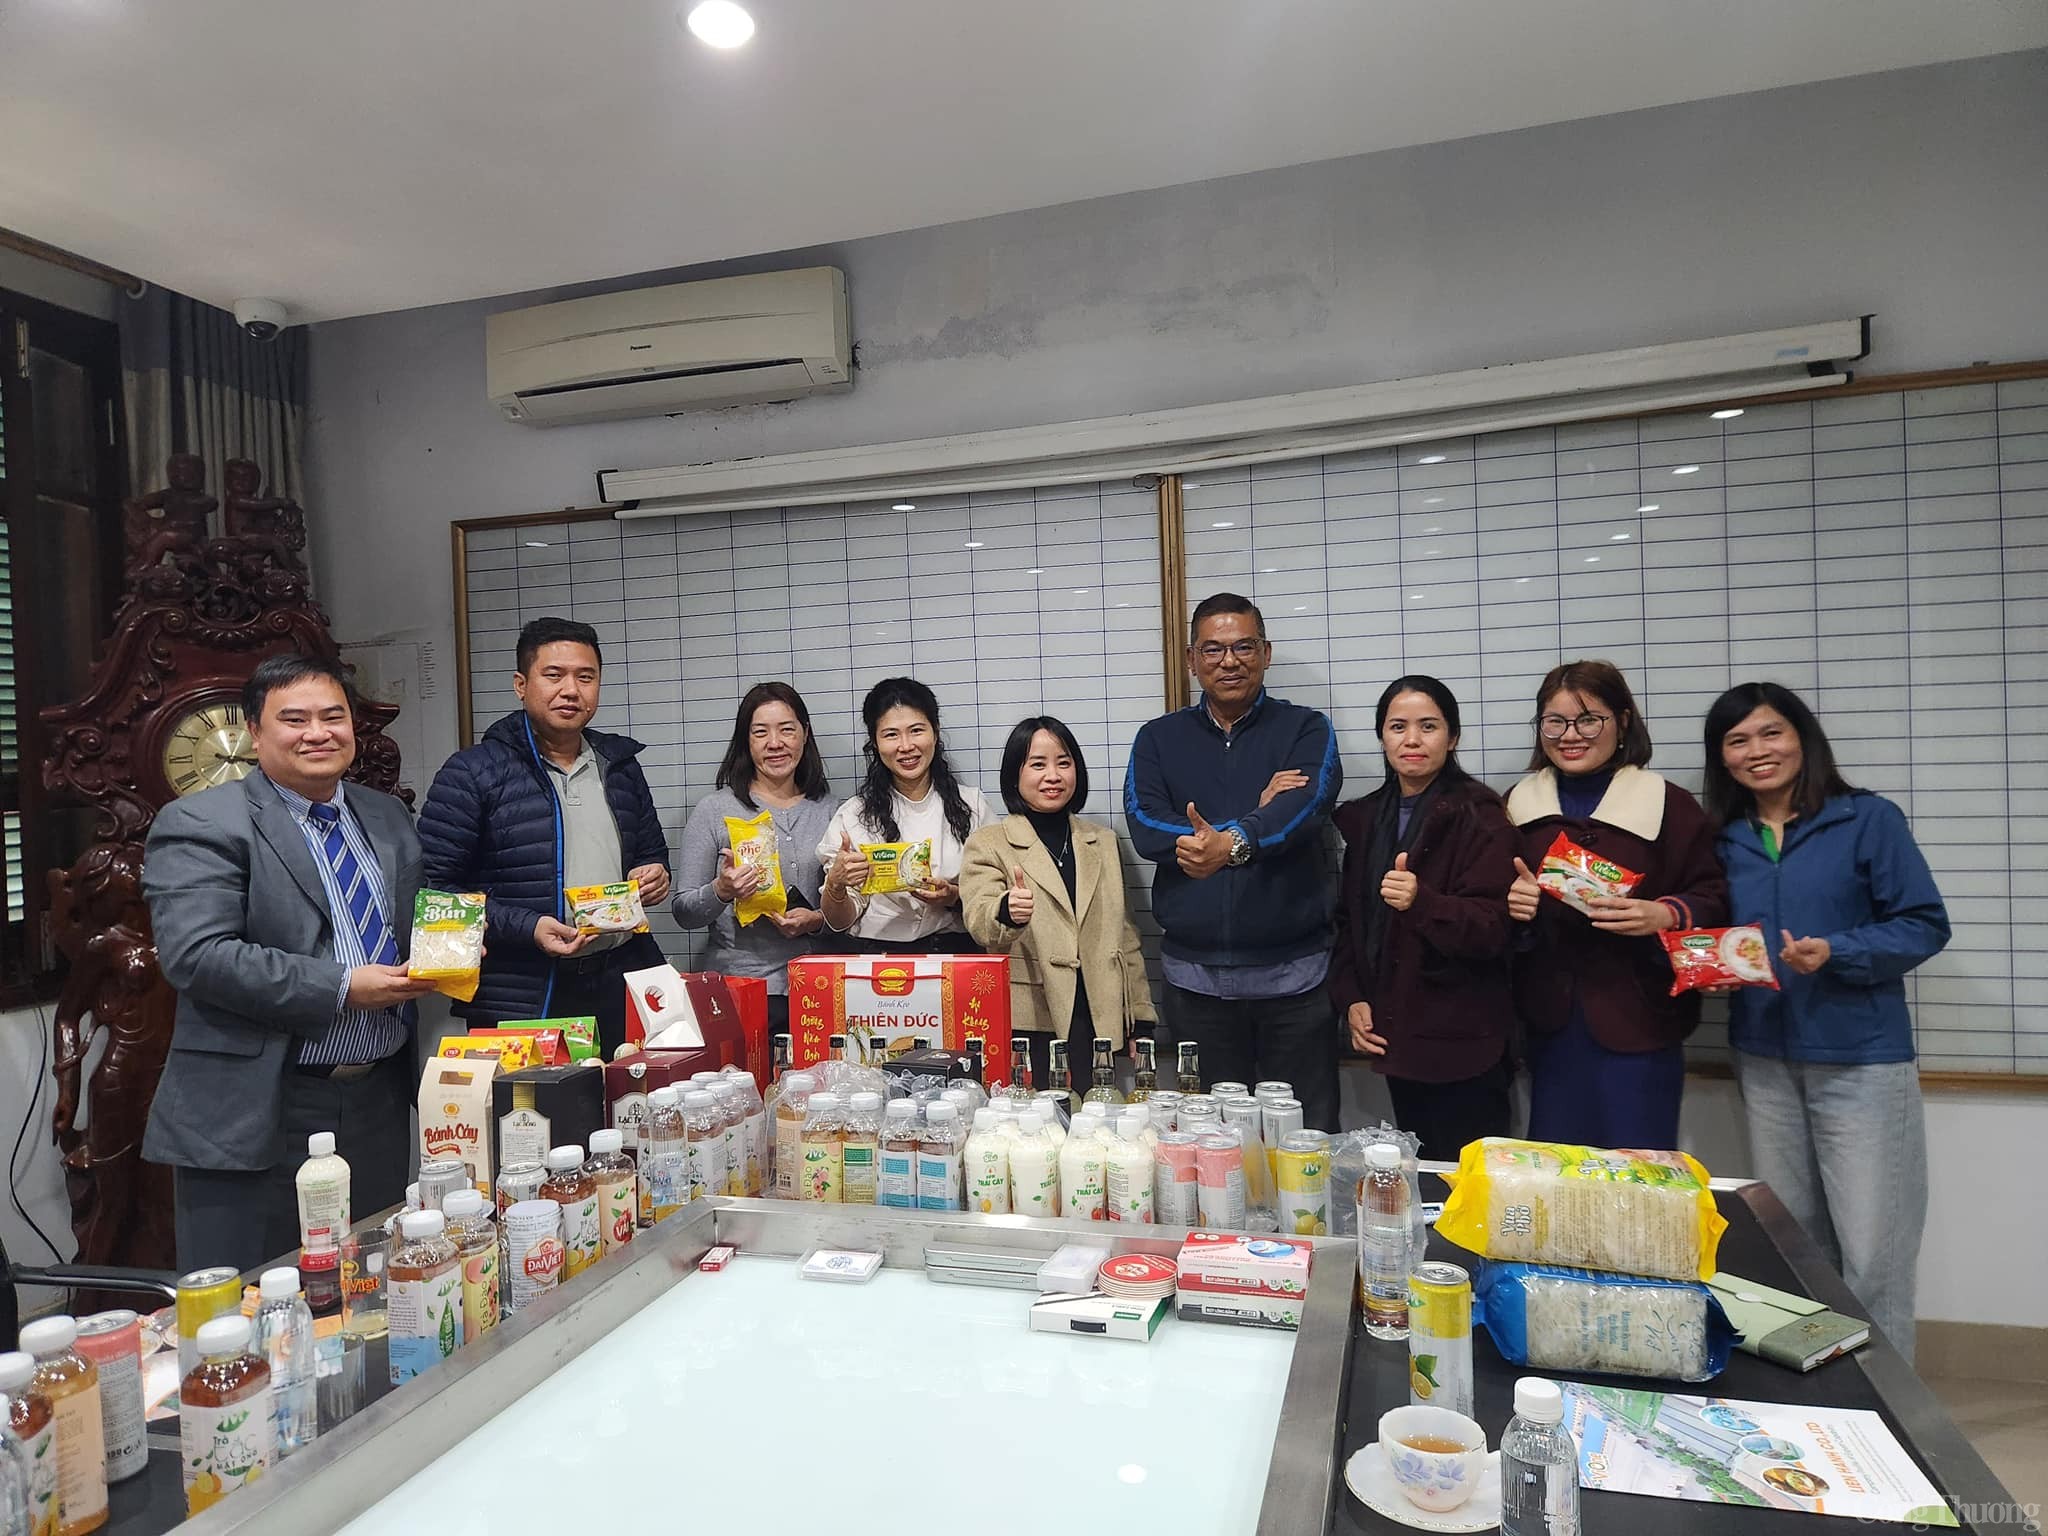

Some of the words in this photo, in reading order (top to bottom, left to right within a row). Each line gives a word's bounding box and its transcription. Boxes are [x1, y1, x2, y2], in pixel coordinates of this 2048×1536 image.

[422, 904, 467, 922] Bún
[849, 1012, 898, 1027] THIÊN
[904, 1012, 939, 1027] ĐỨC
[424, 1124, 455, 1144] Bánh
[455, 1123, 478, 1144] Cáy
[1501, 1206, 1516, 1236] Vua
[1515, 1205, 1531, 1236] Phở
